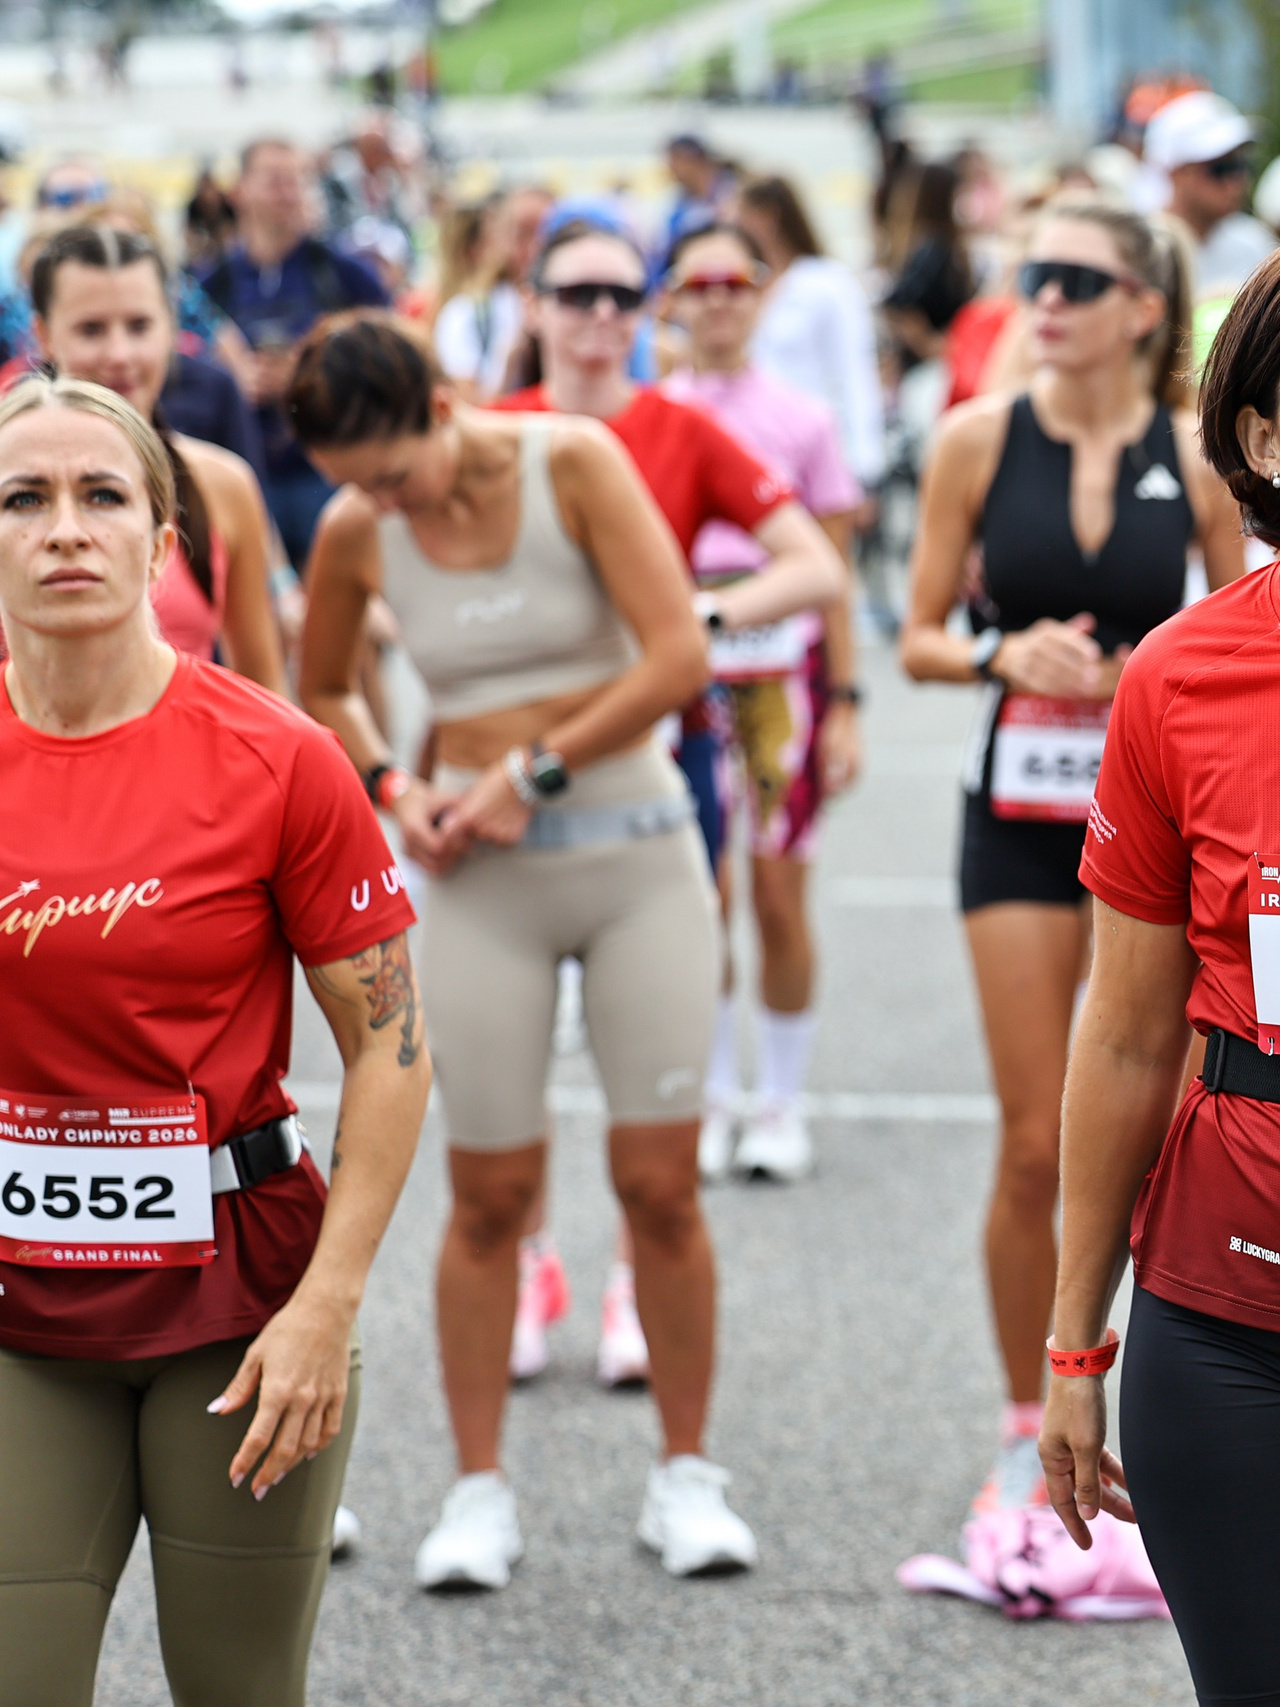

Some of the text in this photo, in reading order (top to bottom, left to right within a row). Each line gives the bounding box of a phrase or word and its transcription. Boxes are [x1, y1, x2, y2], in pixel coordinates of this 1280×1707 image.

[1261, 867, 1279, 877] IRON
[0, 1123, 198, 1144] NLADY СИРИУС 2026
[2, 1170, 176, 1220] 6552
[53, 1249, 109, 1262] GRAND
[113, 1249, 163, 1262] FINAL
